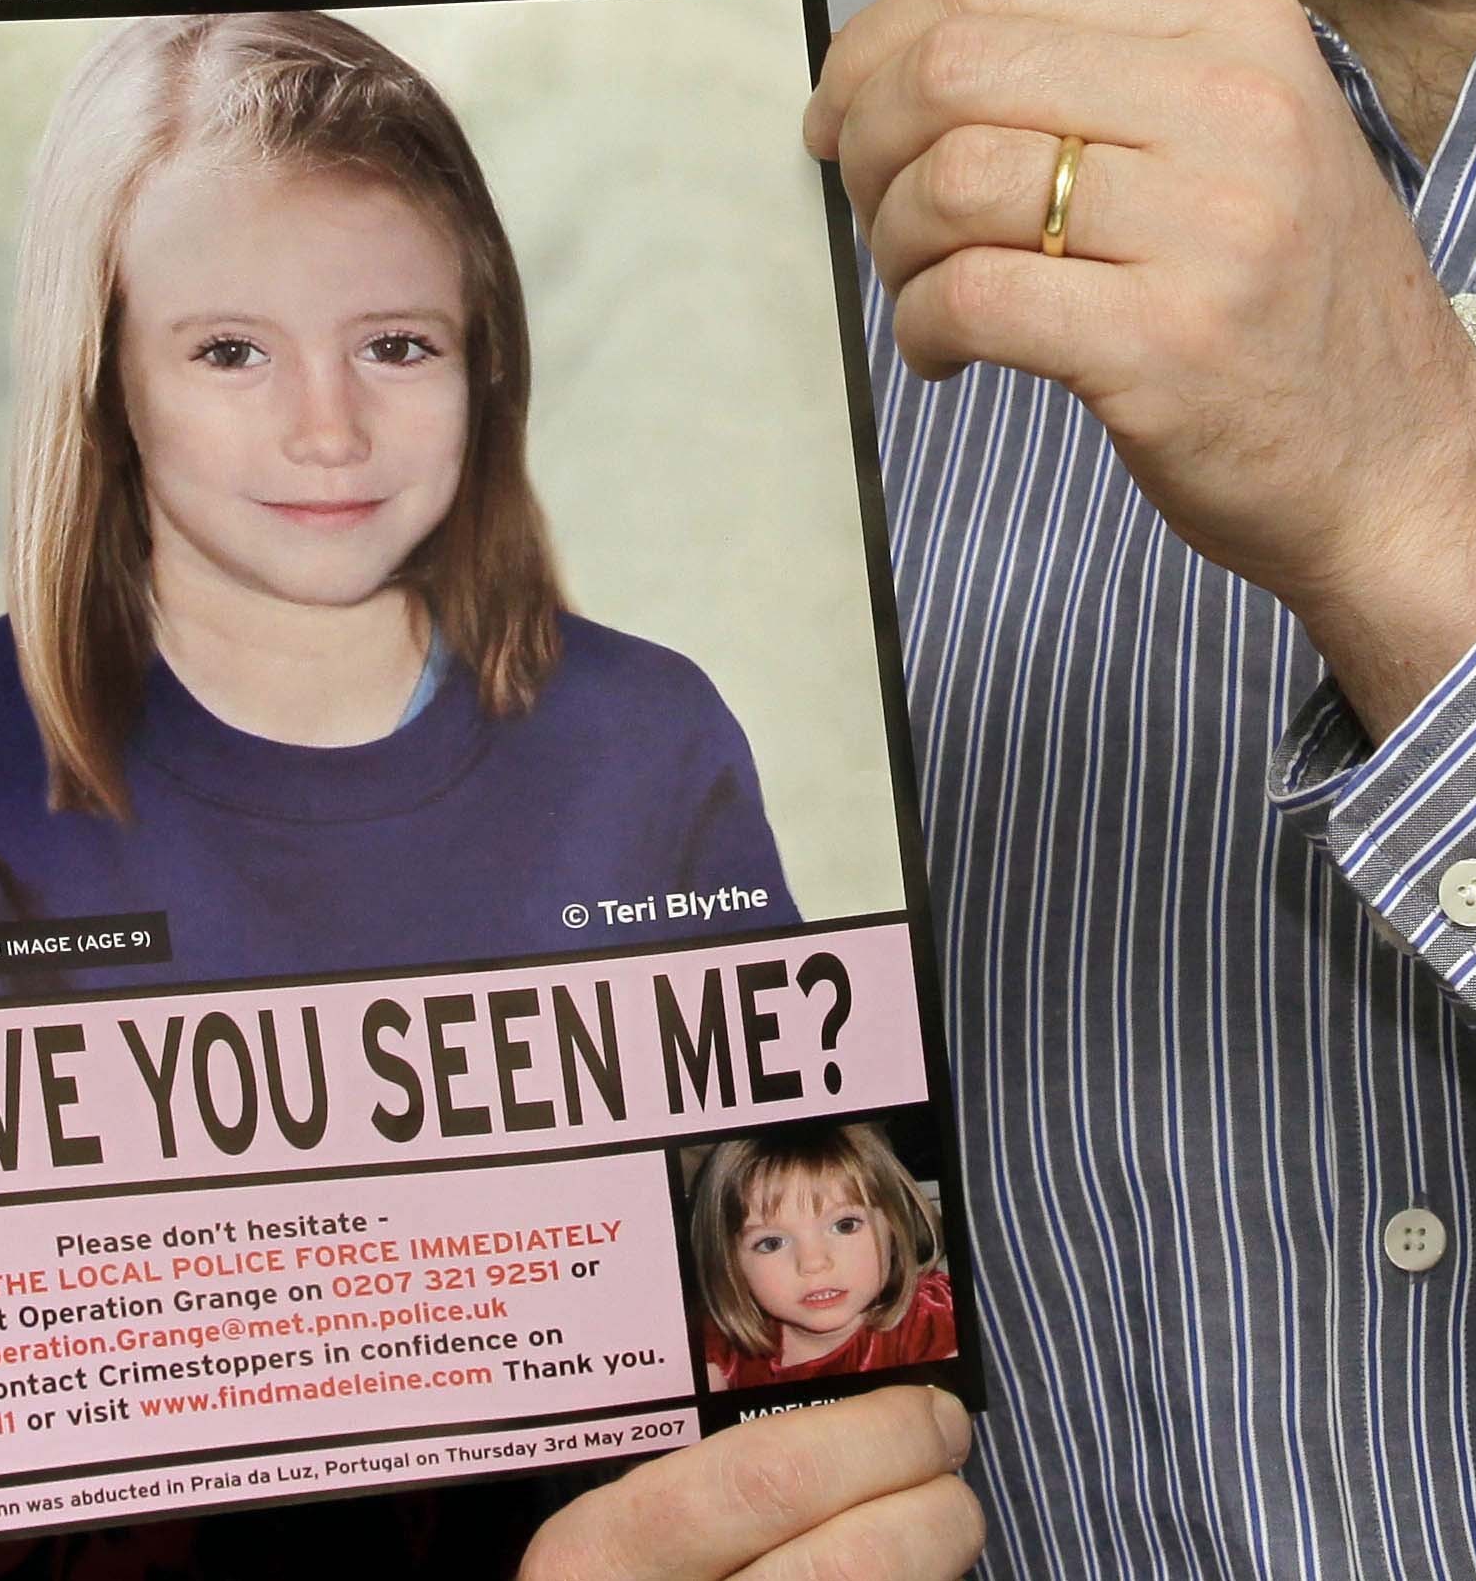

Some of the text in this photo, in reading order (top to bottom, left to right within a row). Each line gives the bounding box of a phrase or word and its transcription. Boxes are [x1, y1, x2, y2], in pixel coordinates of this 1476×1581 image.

[597, 895, 657, 925] Teri
[665, 885, 768, 921] Blythe
[6, 936, 72, 956] IMAGE
[77, 932, 126, 953] (AGE
[130, 930, 151, 948] 9)
[117, 1006, 329, 1159] YOU
[361, 980, 627, 1144] SEEN
[652, 951, 852, 1115] ME?
[56, 1233, 152, 1258] Please
[162, 1221, 237, 1248] don't
[247, 1212, 368, 1241] hesitate
[58, 1260, 163, 1291] LOCAL
[172, 1249, 286, 1280] POLICE
[295, 1240, 400, 1270] FORCE
[409, 1219, 622, 1260] IMMEDIATELY
[18, 1295, 163, 1332] Operation
[173, 1287, 278, 1312] Grange
[288, 1284, 323, 1302] on
[332, 1271, 412, 1298] 0207
[424, 1266, 476, 1291] 321
[486, 1259, 559, 1287] 9251
[571, 1259, 601, 1279] or
[26, 1411, 56, 1431] or
[66, 1397, 131, 1426] visit
[139, 1367, 493, 1417] www.findmadeleine.com
[502, 1352, 594, 1382] Thank
[602, 1348, 665, 1376] you.
[98, 1349, 314, 1387] Crimestoppers
[323, 1342, 350, 1364] in
[360, 1332, 519, 1361] confidence
[528, 1328, 564, 1347] on
[26, 1496, 64, 1513] was
[70, 1481, 161, 1507] abducted
[166, 1479, 185, 1495] in
[190, 1472, 242, 1492] Praia
[247, 1469, 271, 1485] da
[277, 1466, 319, 1482] Luz,
[324, 1452, 410, 1476] Portugal
[416, 1452, 440, 1466] on
[444, 1441, 538, 1463] Thursday
[544, 1434, 578, 1453] 3rd
[583, 1430, 624, 1448] May
[630, 1419, 686, 1442] 2007
